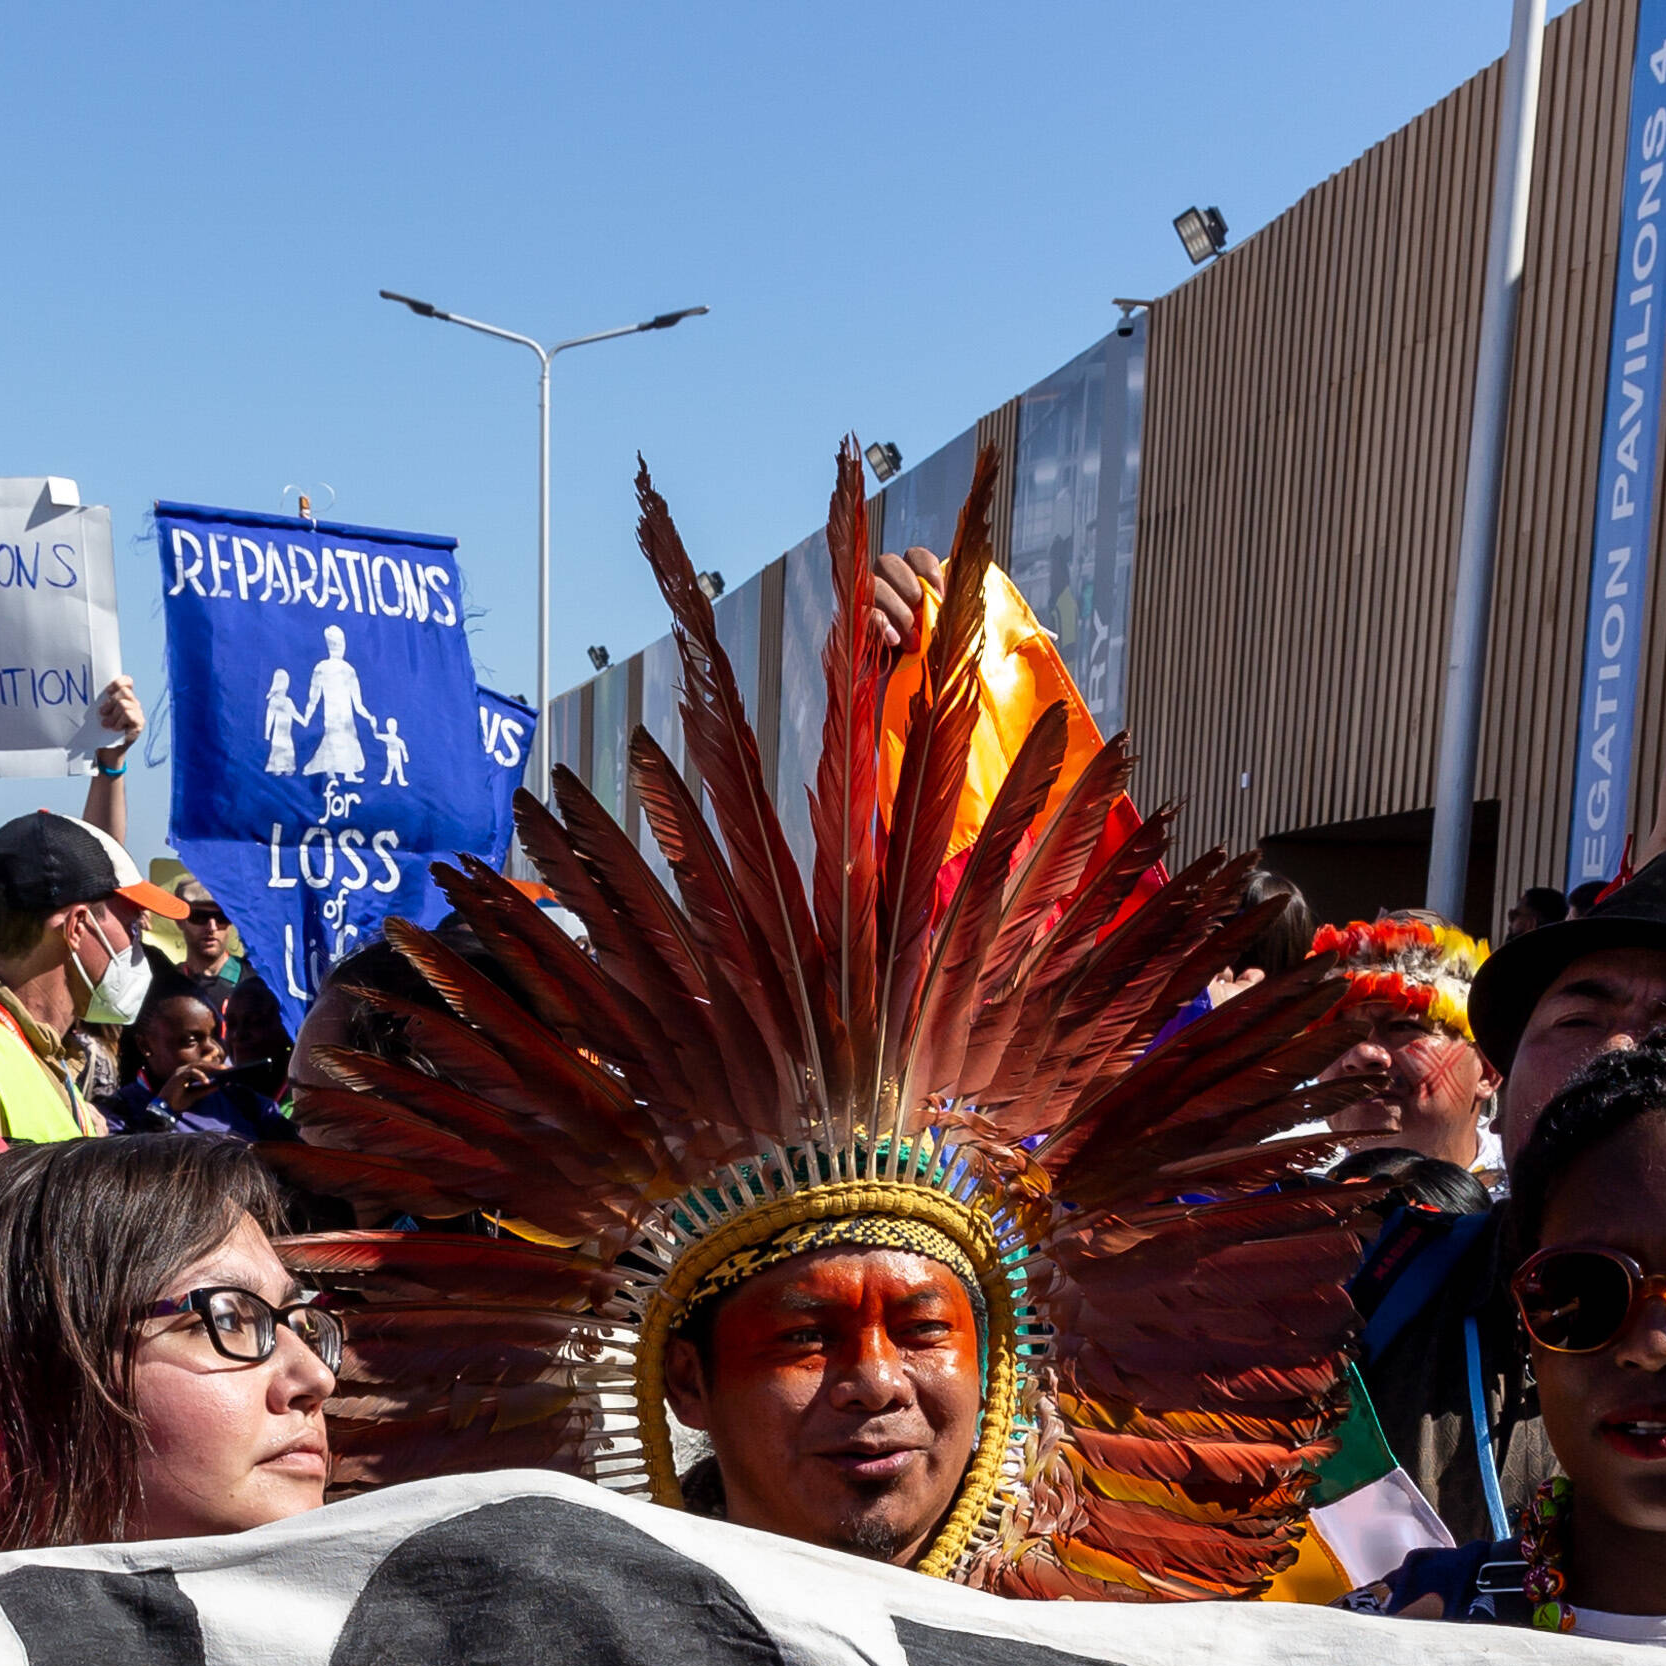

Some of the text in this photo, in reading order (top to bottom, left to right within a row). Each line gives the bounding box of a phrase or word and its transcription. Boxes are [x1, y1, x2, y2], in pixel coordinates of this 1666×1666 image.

[168, 528, 458, 628] REPARATIONS
[1582, 547, 1631, 878] EGATION
[318, 779, 361, 824] for
[267, 822, 401, 893] LOSS
[323, 888, 350, 930] of
[285, 923, 359, 1001] Lif
